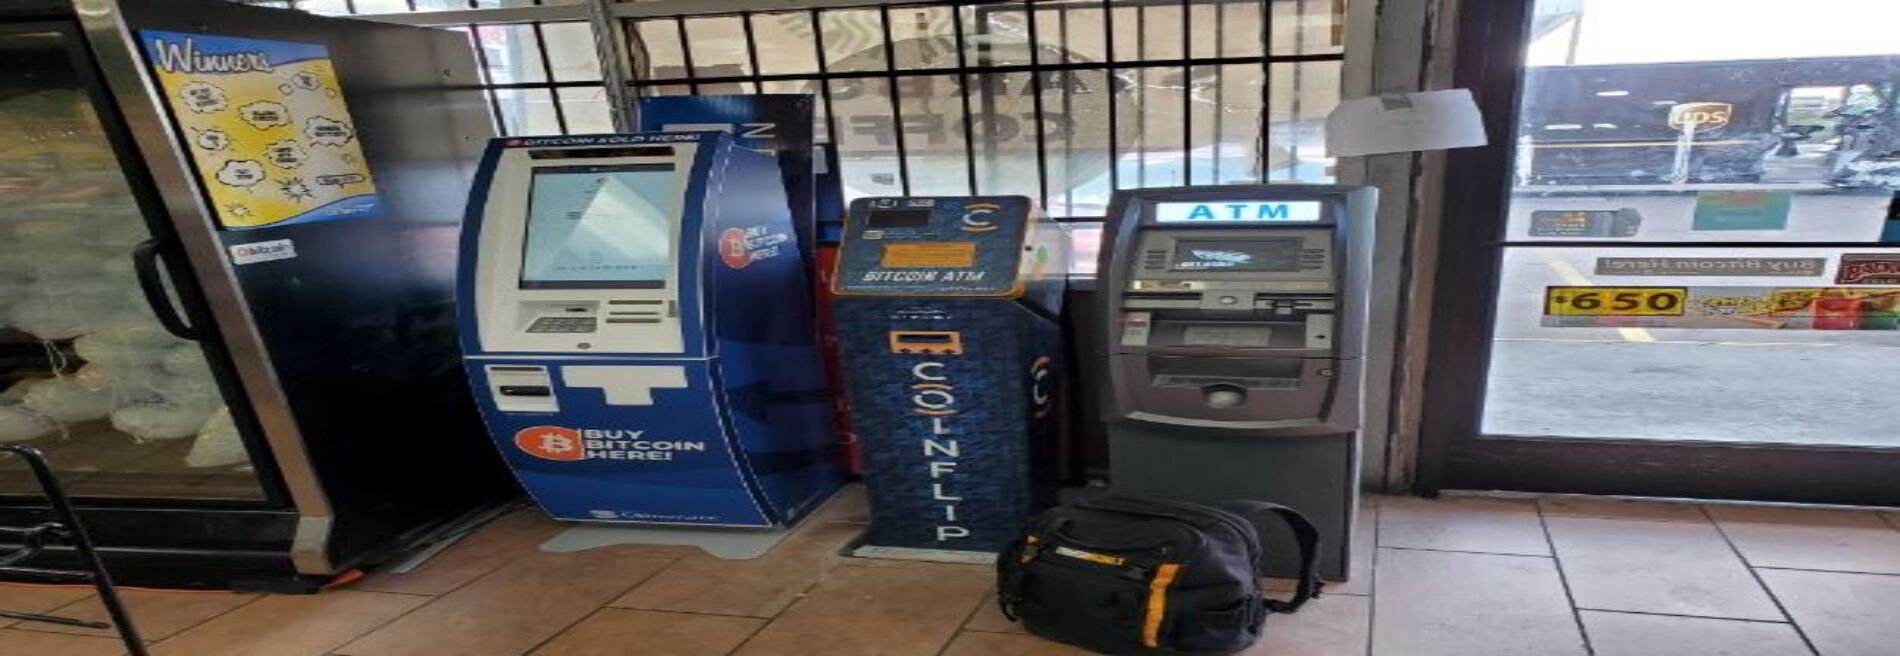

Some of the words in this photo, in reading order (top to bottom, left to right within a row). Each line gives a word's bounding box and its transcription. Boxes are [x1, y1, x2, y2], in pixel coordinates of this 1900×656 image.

[155, 38, 274, 74] Winners
[1187, 204, 1290, 220] ATM
[584, 429, 644, 440] BUY
[584, 441, 704, 451] BITCOIN
[584, 451, 673, 461] HERE!
